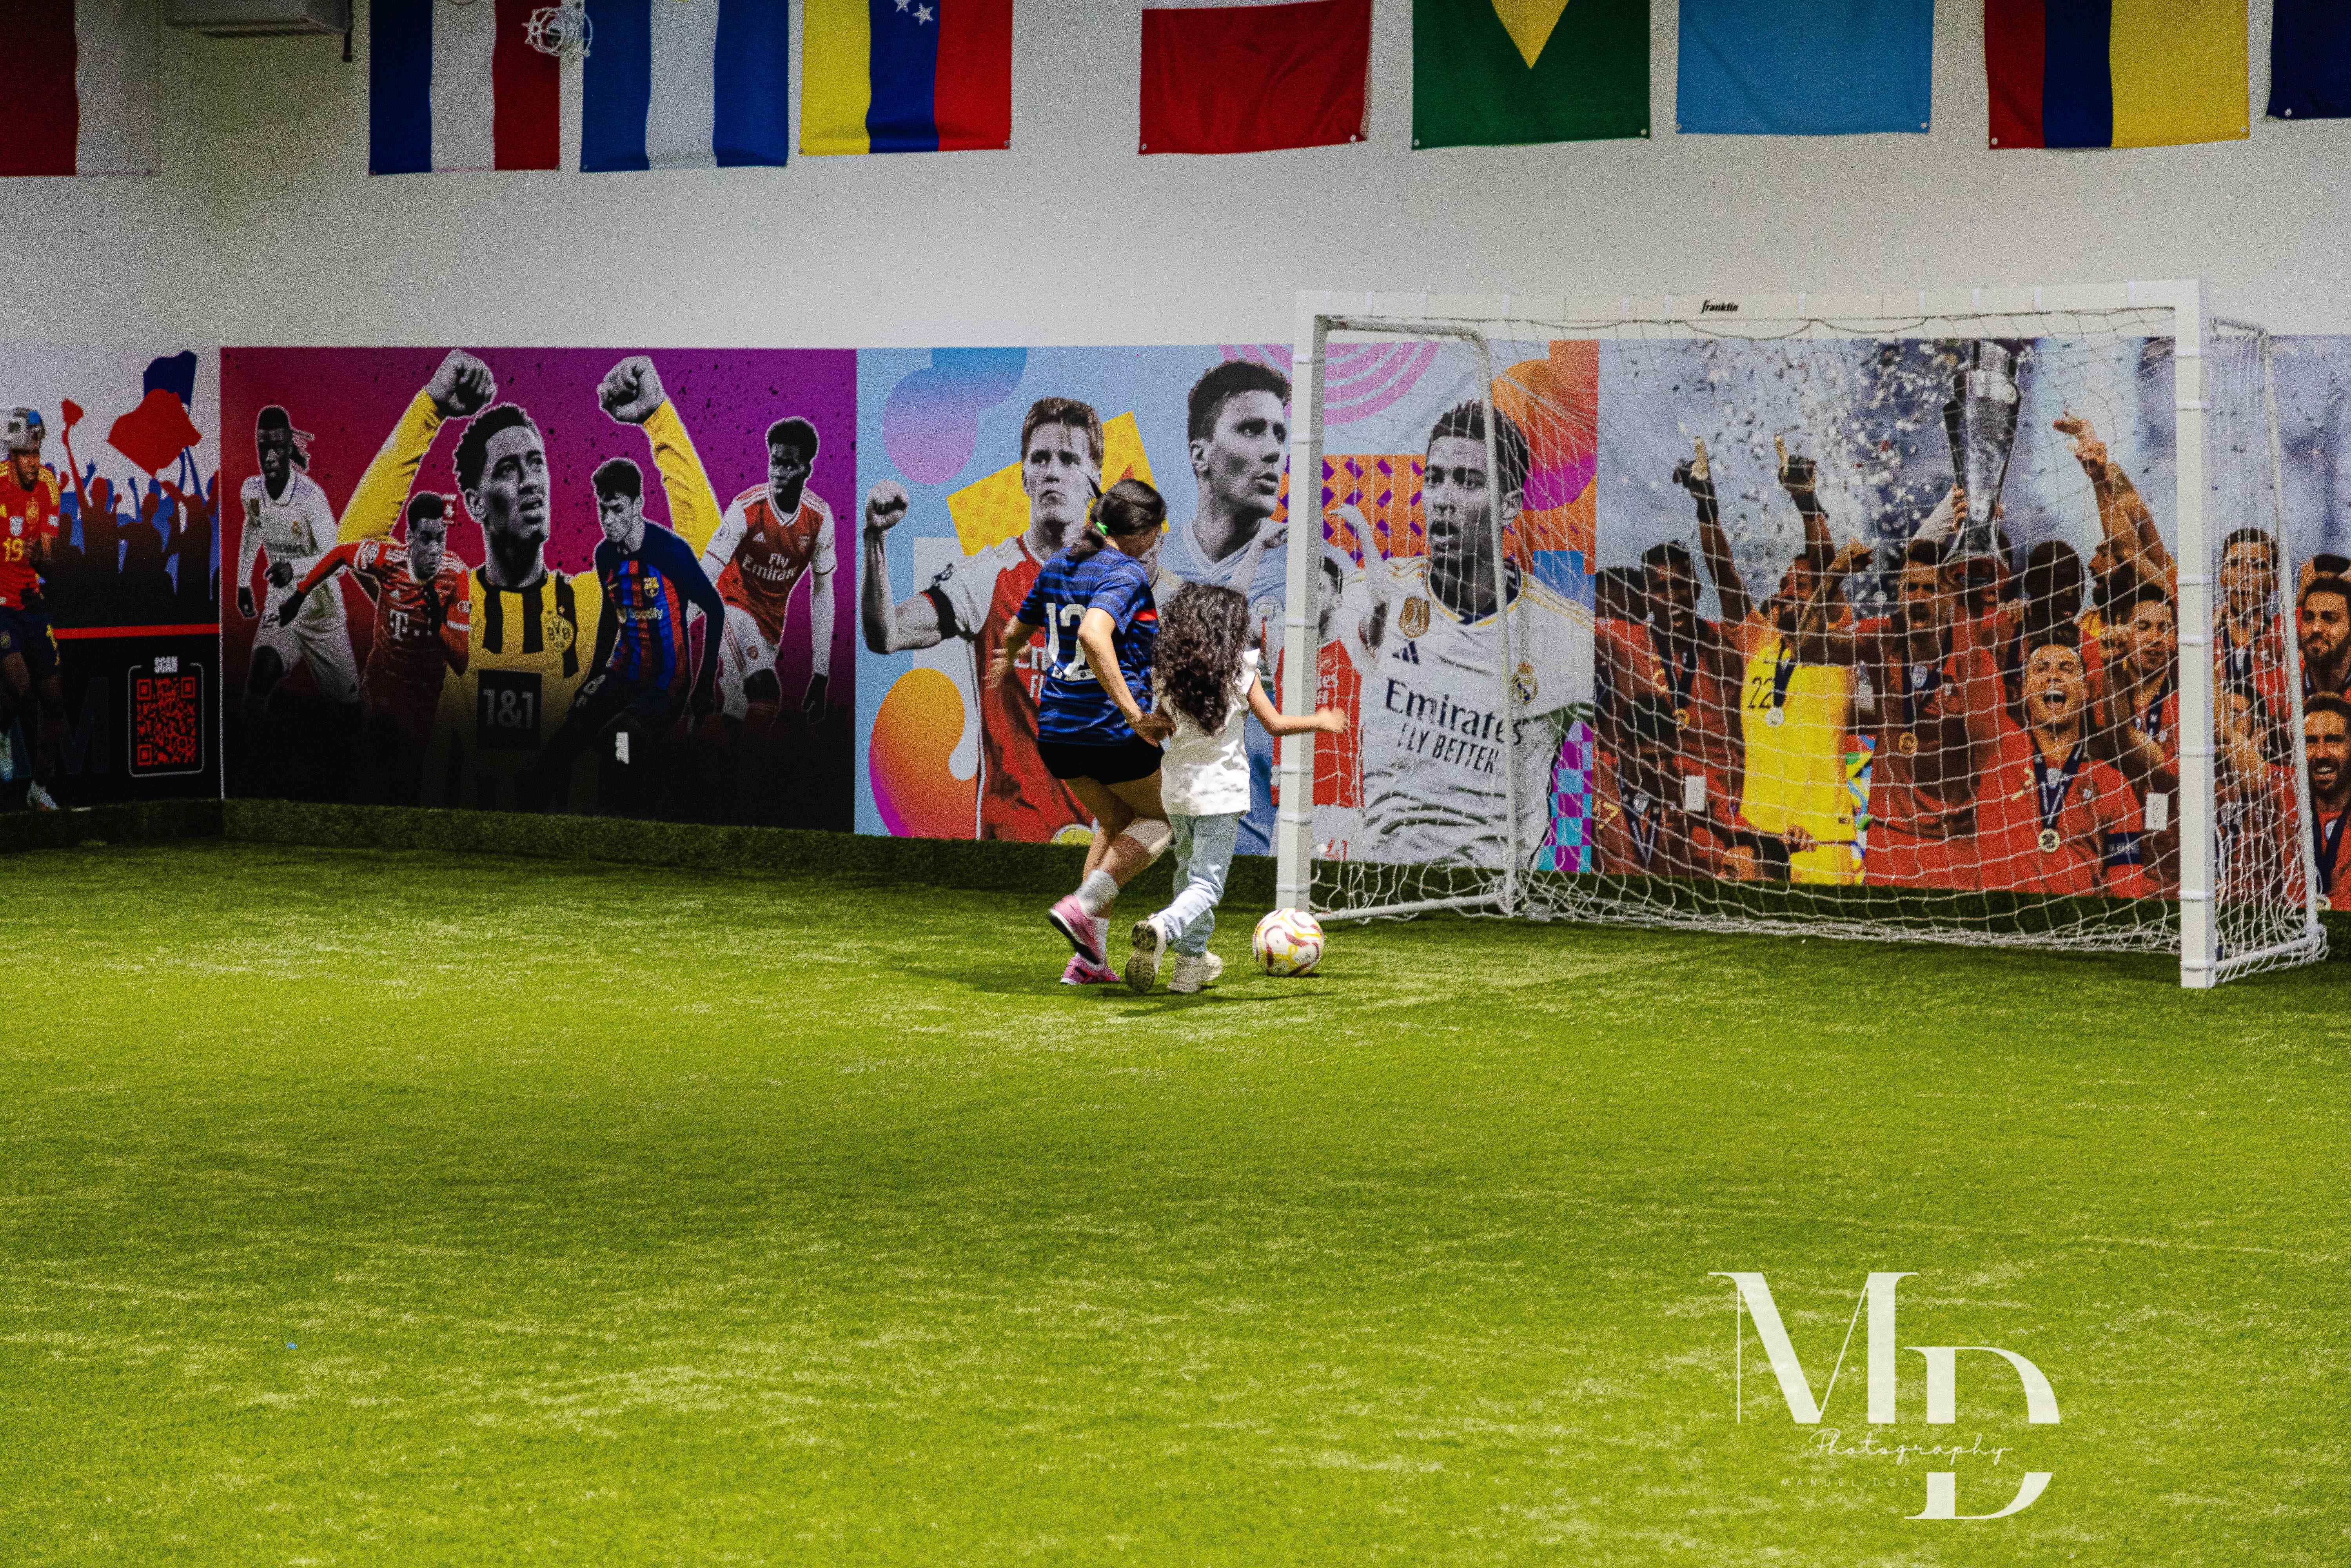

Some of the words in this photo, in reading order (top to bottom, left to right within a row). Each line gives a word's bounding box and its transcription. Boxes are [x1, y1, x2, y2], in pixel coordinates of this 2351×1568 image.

[2, 537, 24, 562] 19
[768, 552, 791, 568] Fly
[628, 607, 663, 621] Spotify
[547, 620, 571, 641] BVB
[153, 655, 179, 674] SCAN
[1748, 676, 1775, 709] 22
[482, 688, 534, 730] 1&1
[1385, 678, 1523, 746] Emirates
[1397, 722, 1430, 754] FLY
[1431, 733, 1500, 774] BETTER
